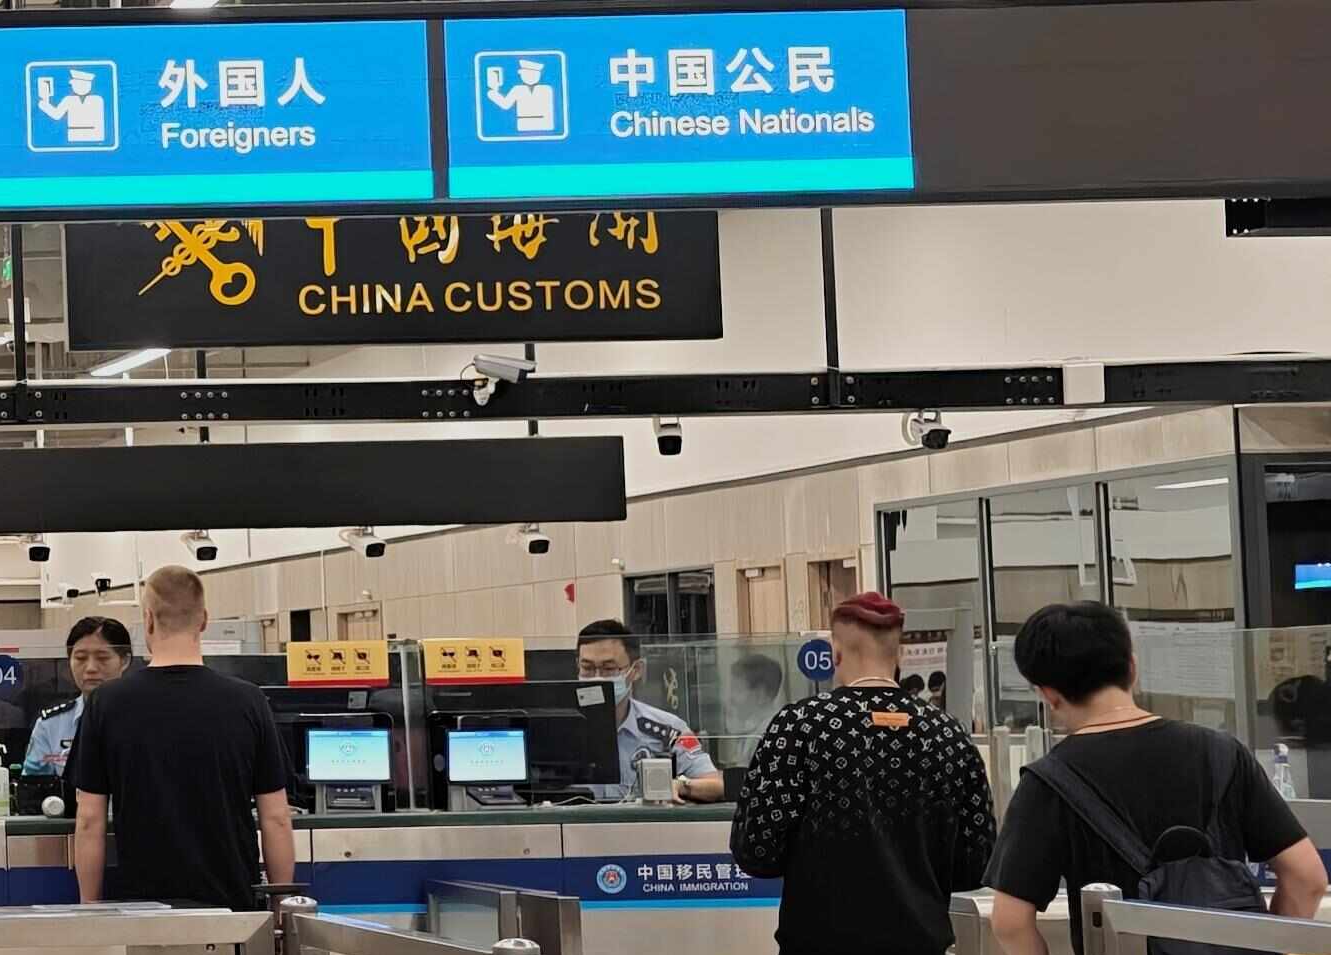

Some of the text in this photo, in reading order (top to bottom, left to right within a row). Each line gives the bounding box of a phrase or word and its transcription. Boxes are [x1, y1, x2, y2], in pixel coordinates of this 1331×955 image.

[158, 57, 326, 109] 外国人
[609, 46, 835, 98] 中国公民
[161, 121, 316, 154] Foreigners
[610, 106, 875, 138] Chinese Nationals
[298, 279, 662, 316] CHINA CUSTOMS
[804, 650, 832, 671] 05
[642, 881, 749, 893] CHINA IMMIGRATION
